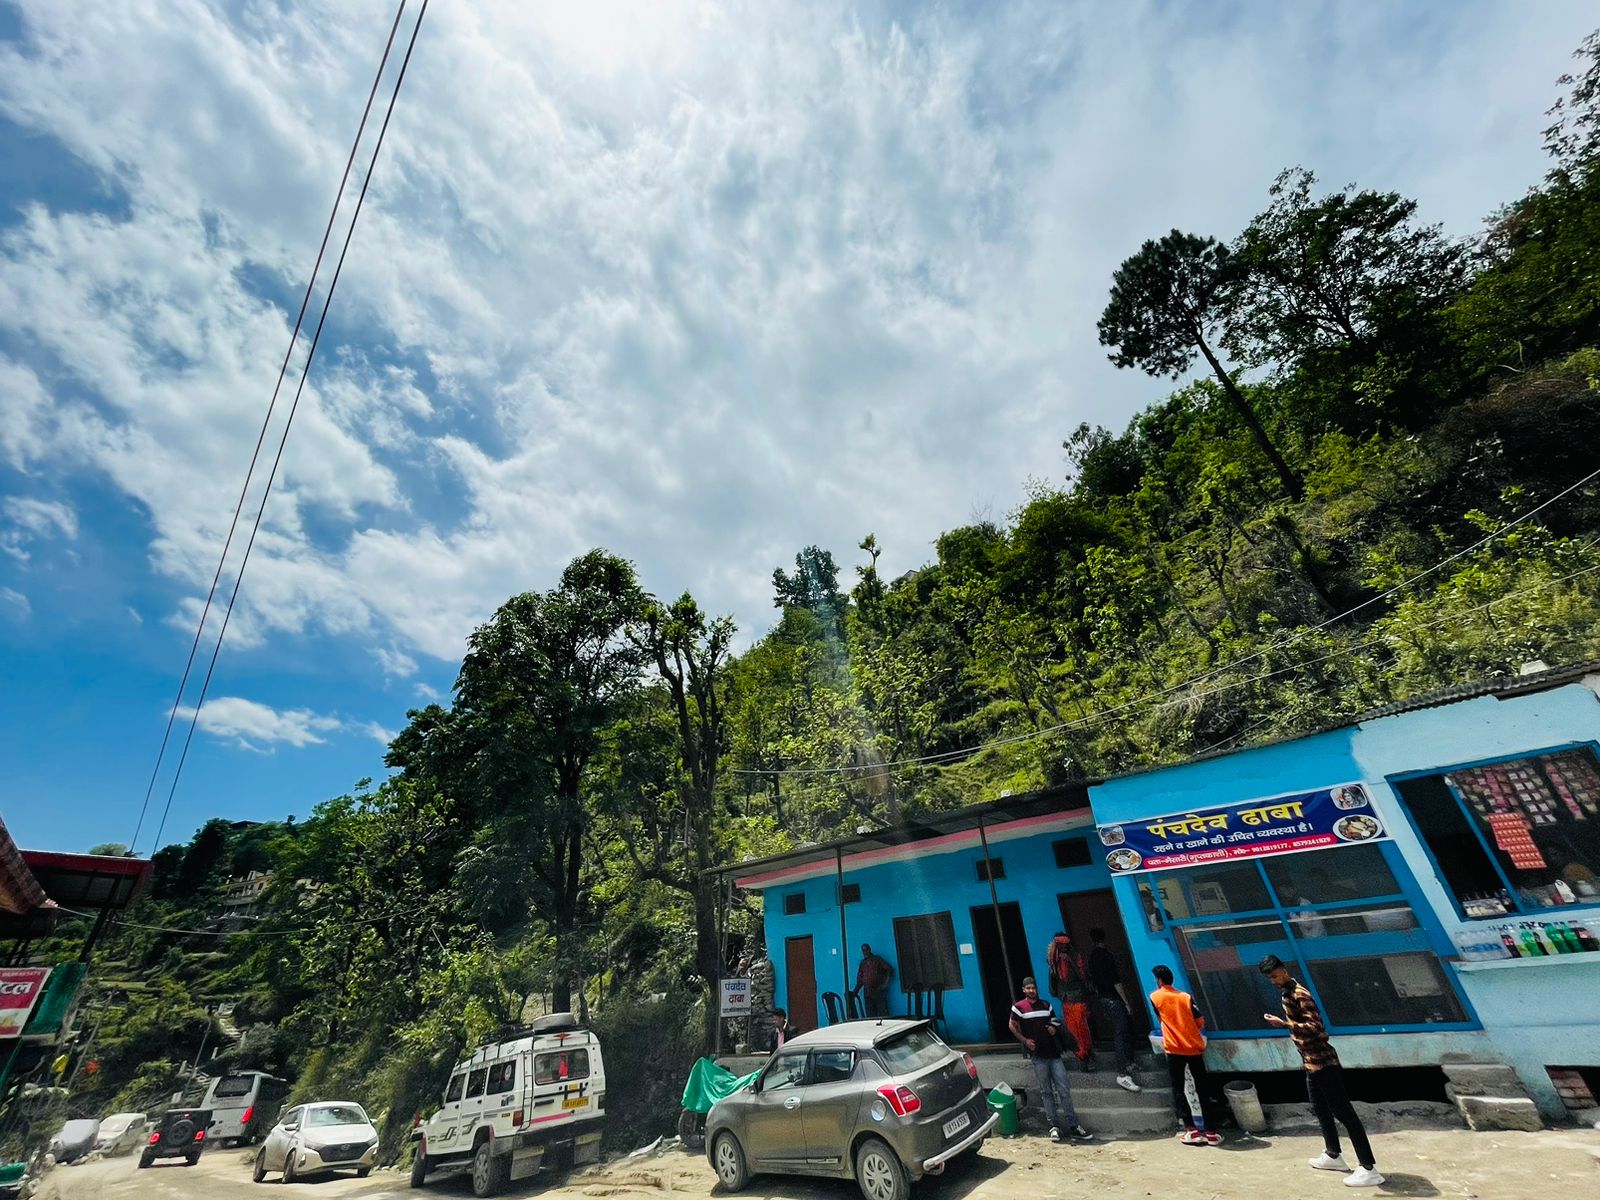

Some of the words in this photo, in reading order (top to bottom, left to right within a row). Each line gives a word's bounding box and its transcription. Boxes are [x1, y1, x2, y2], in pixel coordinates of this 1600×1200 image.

[1146, 813, 1228, 838] पंचदेव
[1237, 801, 1305, 826] ढाबा
[1153, 841, 1174, 853] रहने
[1175, 842, 1184, 850] व
[1185, 837, 1209, 848] खाने
[1209, 834, 1225, 844] की
[1226, 831, 1255, 842] उचित
[1255, 825, 1296, 837] व्यवस्था
[724, 981, 747, 991] पंचदेव
